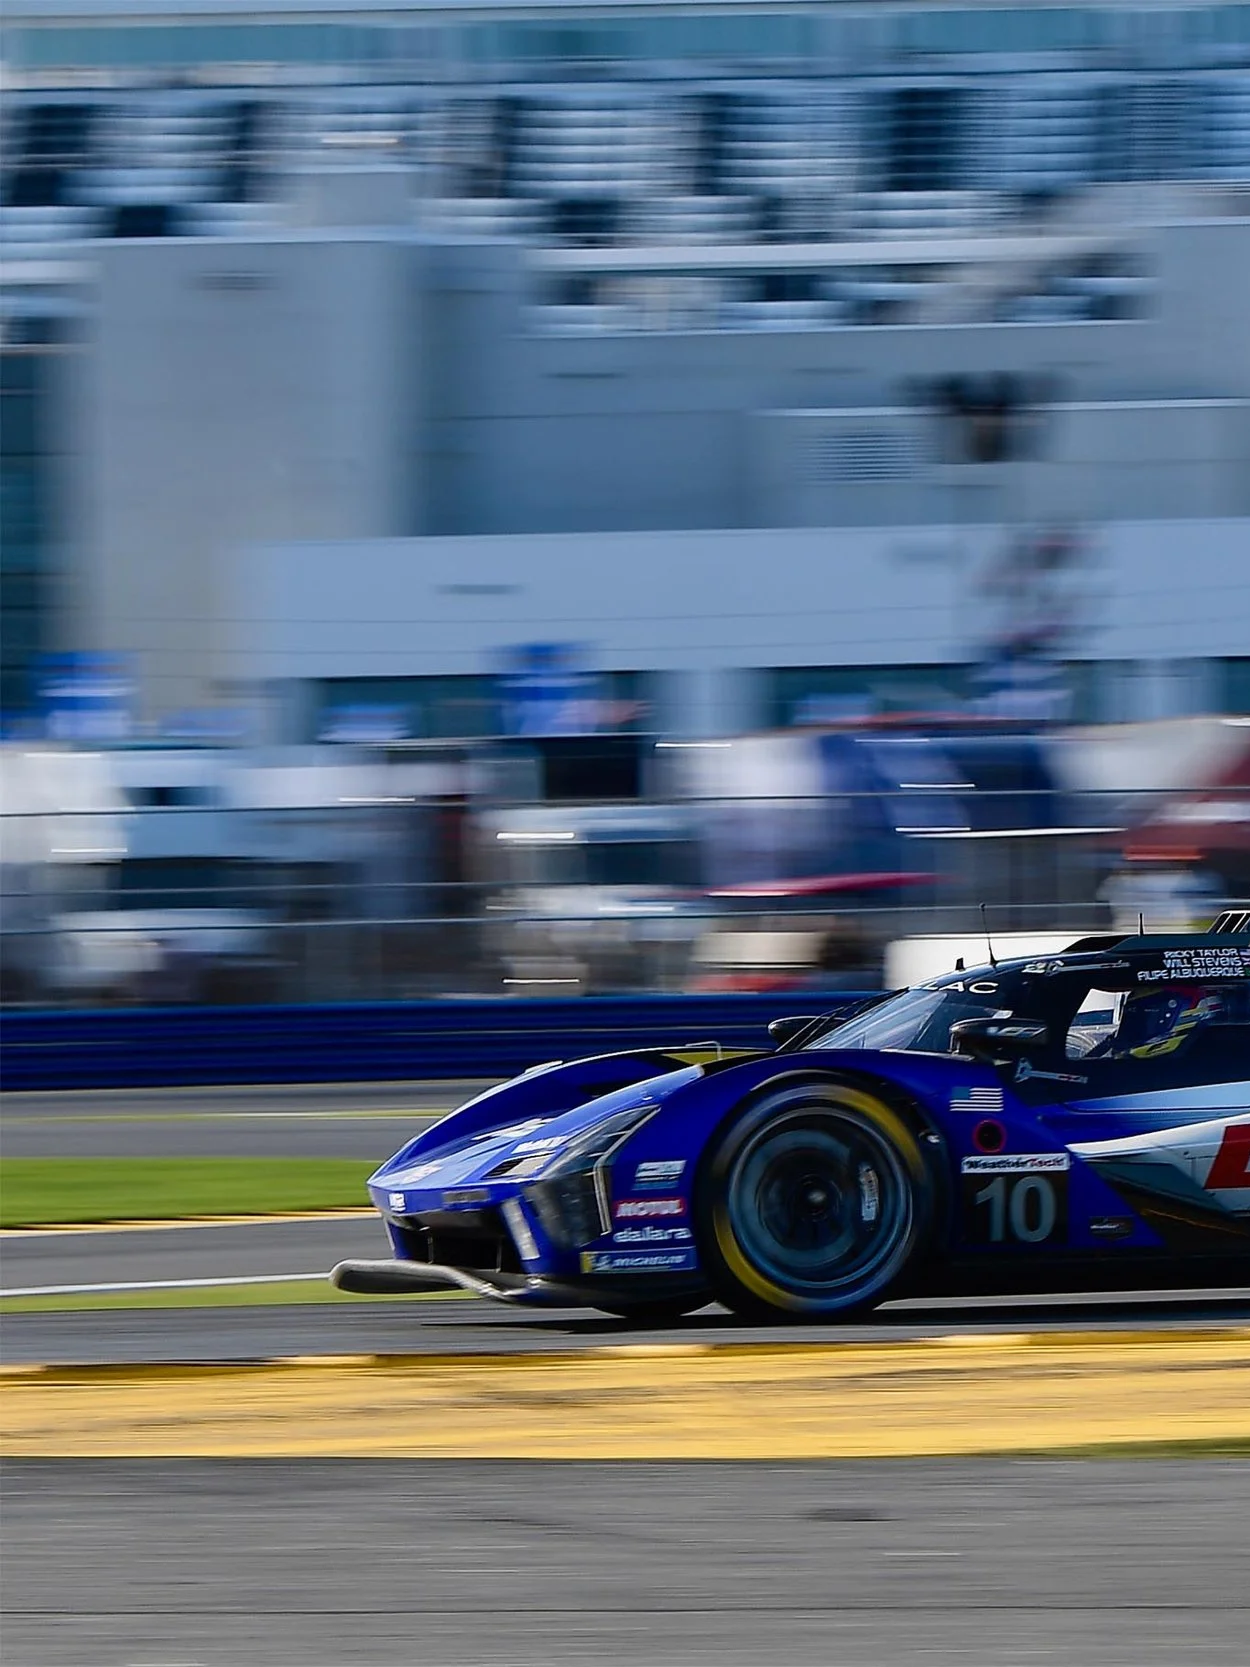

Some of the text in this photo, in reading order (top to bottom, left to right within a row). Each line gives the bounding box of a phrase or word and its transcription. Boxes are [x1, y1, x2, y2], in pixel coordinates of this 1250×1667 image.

[1164, 948, 1239, 958] RICKY TAYLOR
[1163, 957, 1242, 968] WILL STEVENS
[1137, 967, 1245, 981] FILIPE ALBUQUERQUE
[975, 1175, 1057, 1243] 10
